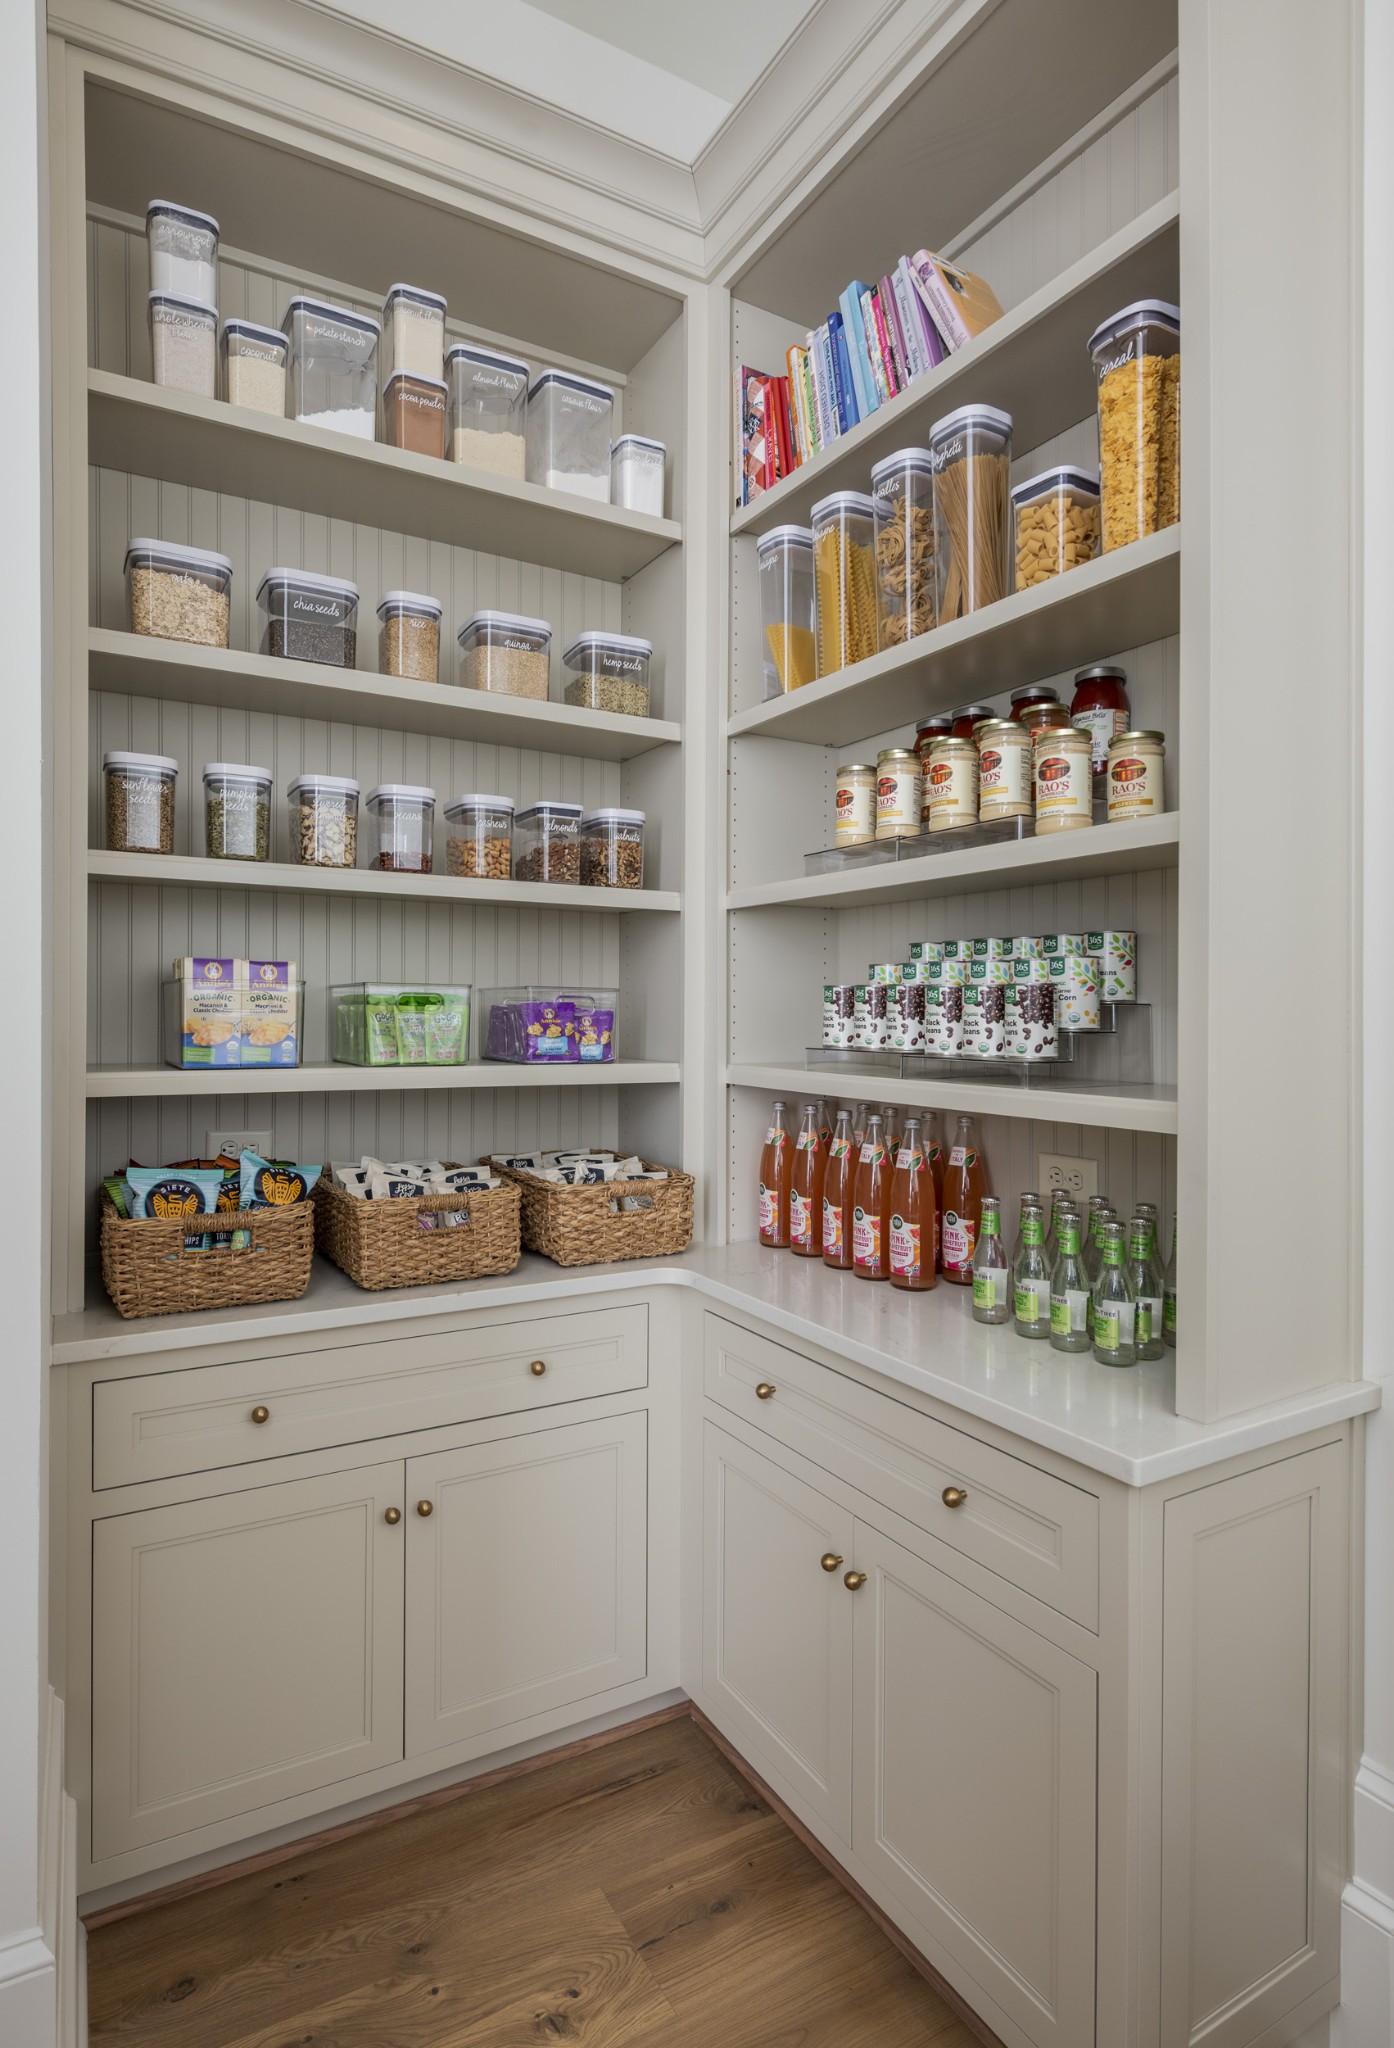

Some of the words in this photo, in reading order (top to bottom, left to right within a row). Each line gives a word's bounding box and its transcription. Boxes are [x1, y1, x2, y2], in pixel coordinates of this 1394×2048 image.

[159, 224, 211, 248] arrowroot
[313, 326, 337, 342] potato
[338, 333, 365, 347] starch
[886, 314, 897, 347] MARTINIS
[893, 353, 903, 376] MOMS
[240, 346, 277, 362] coconut
[1100, 341, 1135, 379] cereal
[472, 371, 499, 386] almond
[817, 368, 827, 391] DISH
[398, 392, 420, 403] cocoa
[419, 395, 446, 412] powder
[820, 391, 830, 429] DEFINED
[171, 572, 194, 586] oats
[293, 596, 315, 611] chia
[315, 602, 340, 617] seeds
[602, 653, 623, 669] hemp
[622, 657, 642, 671] seeds
[122, 777, 170, 795] sunflower
[1038, 781, 1070, 795] RAO'S
[1112, 782, 1146, 796] RAO'S
[129, 794, 156, 805] seeds
[219, 788, 258, 803] pumpkin
[477, 815, 508, 830] cashews
[1088, 937, 1102, 945] 365
[971, 965, 985, 973] 365
[1015, 963, 1029, 972] 365
[1051, 961, 1063, 969] 365
[193, 993, 233, 1002] ORGANIC
[249, 994, 288, 1003] ORGANIC
[965, 990, 977, 999] 365
[160, 1184, 191, 1194] SIETE
[892, 1233, 906, 1245] PINK
[944, 1229, 960, 1241] PINK
